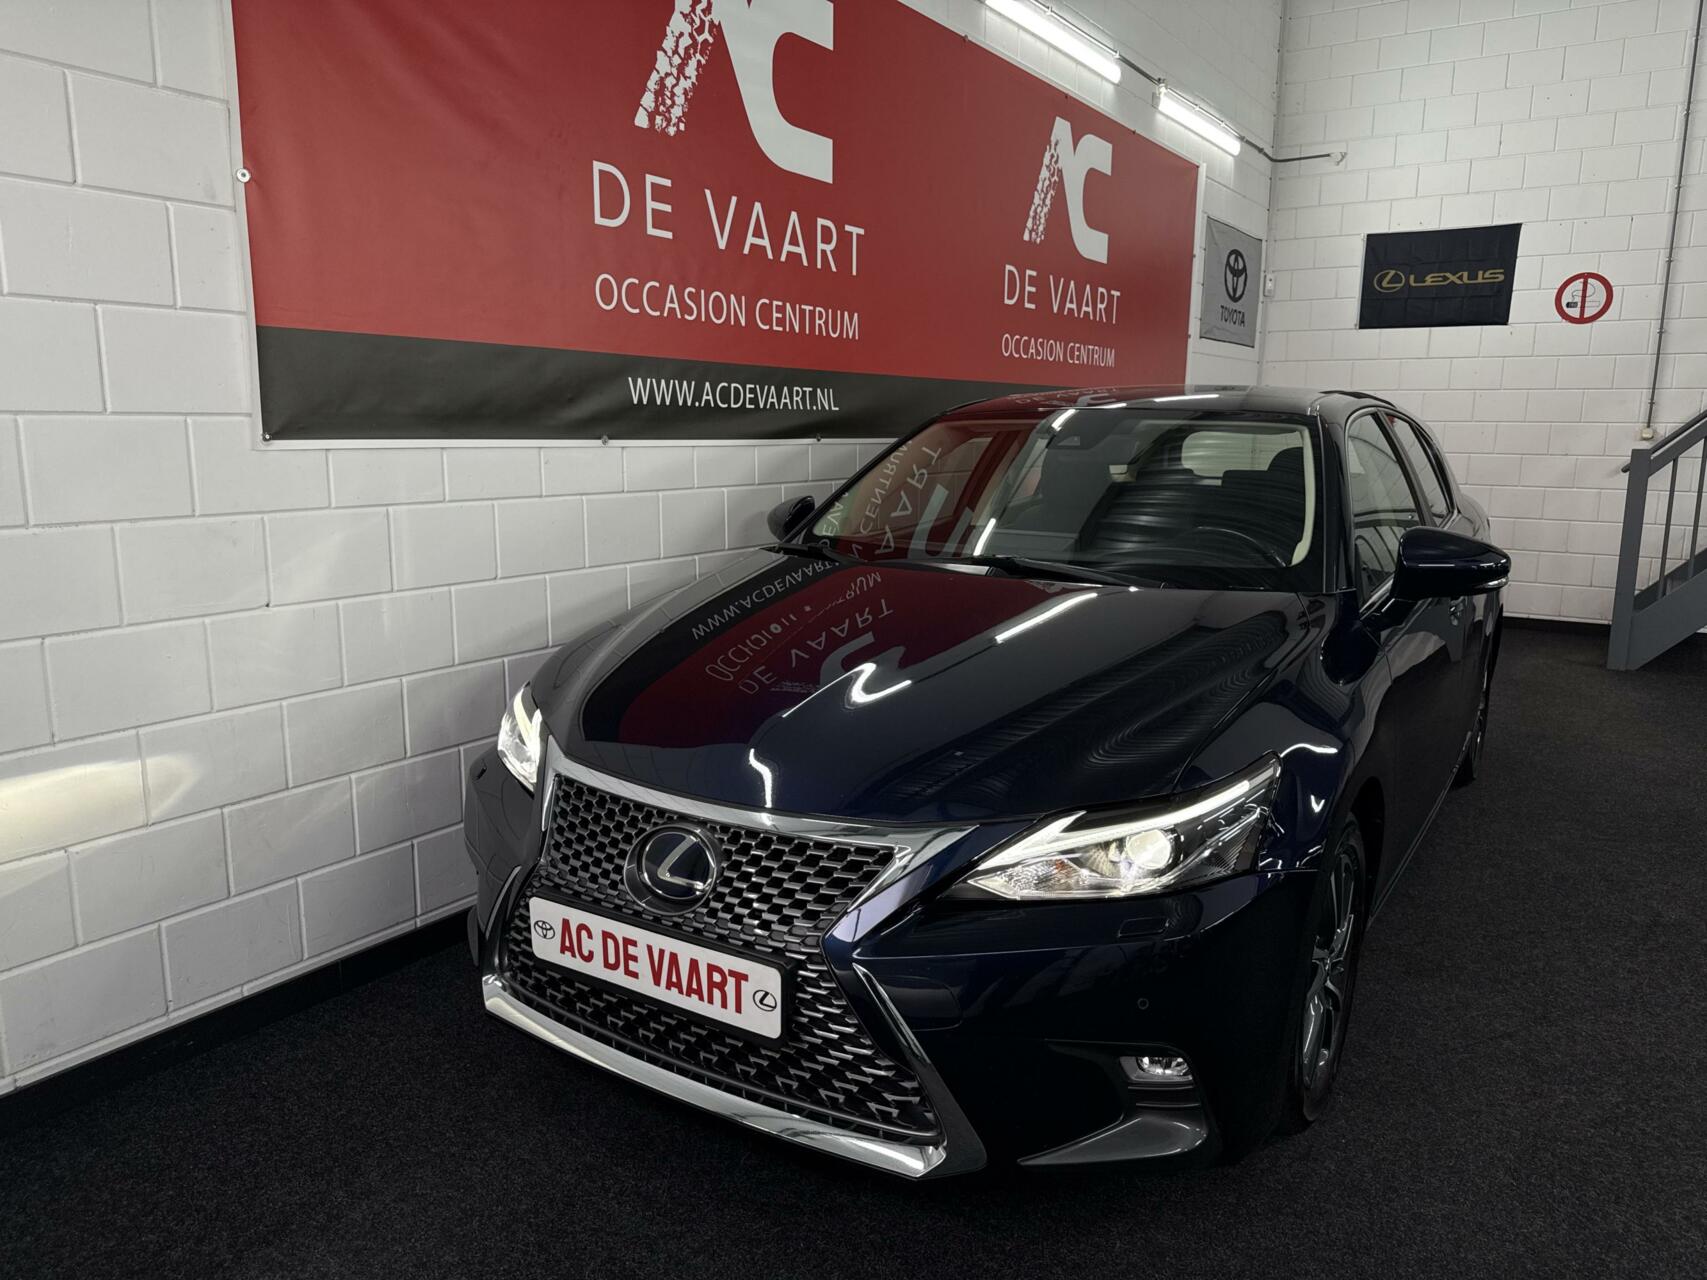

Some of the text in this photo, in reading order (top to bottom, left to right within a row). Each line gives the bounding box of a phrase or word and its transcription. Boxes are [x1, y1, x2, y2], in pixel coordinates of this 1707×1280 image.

[592, 160, 865, 276] DE VAART
[1004, 264, 1121, 324] DE VAART
[1409, 269, 1505, 287] LEXUS
[595, 273, 859, 340] OCCASION CENTRUM
[1220, 304, 1246, 328] TOYOTA
[1001, 333, 1115, 367] OCCASION CENTRUM
[627, 376, 839, 411] WWW.ACDEVAART.NL
[559, 918, 749, 1014] AC DE VAART
